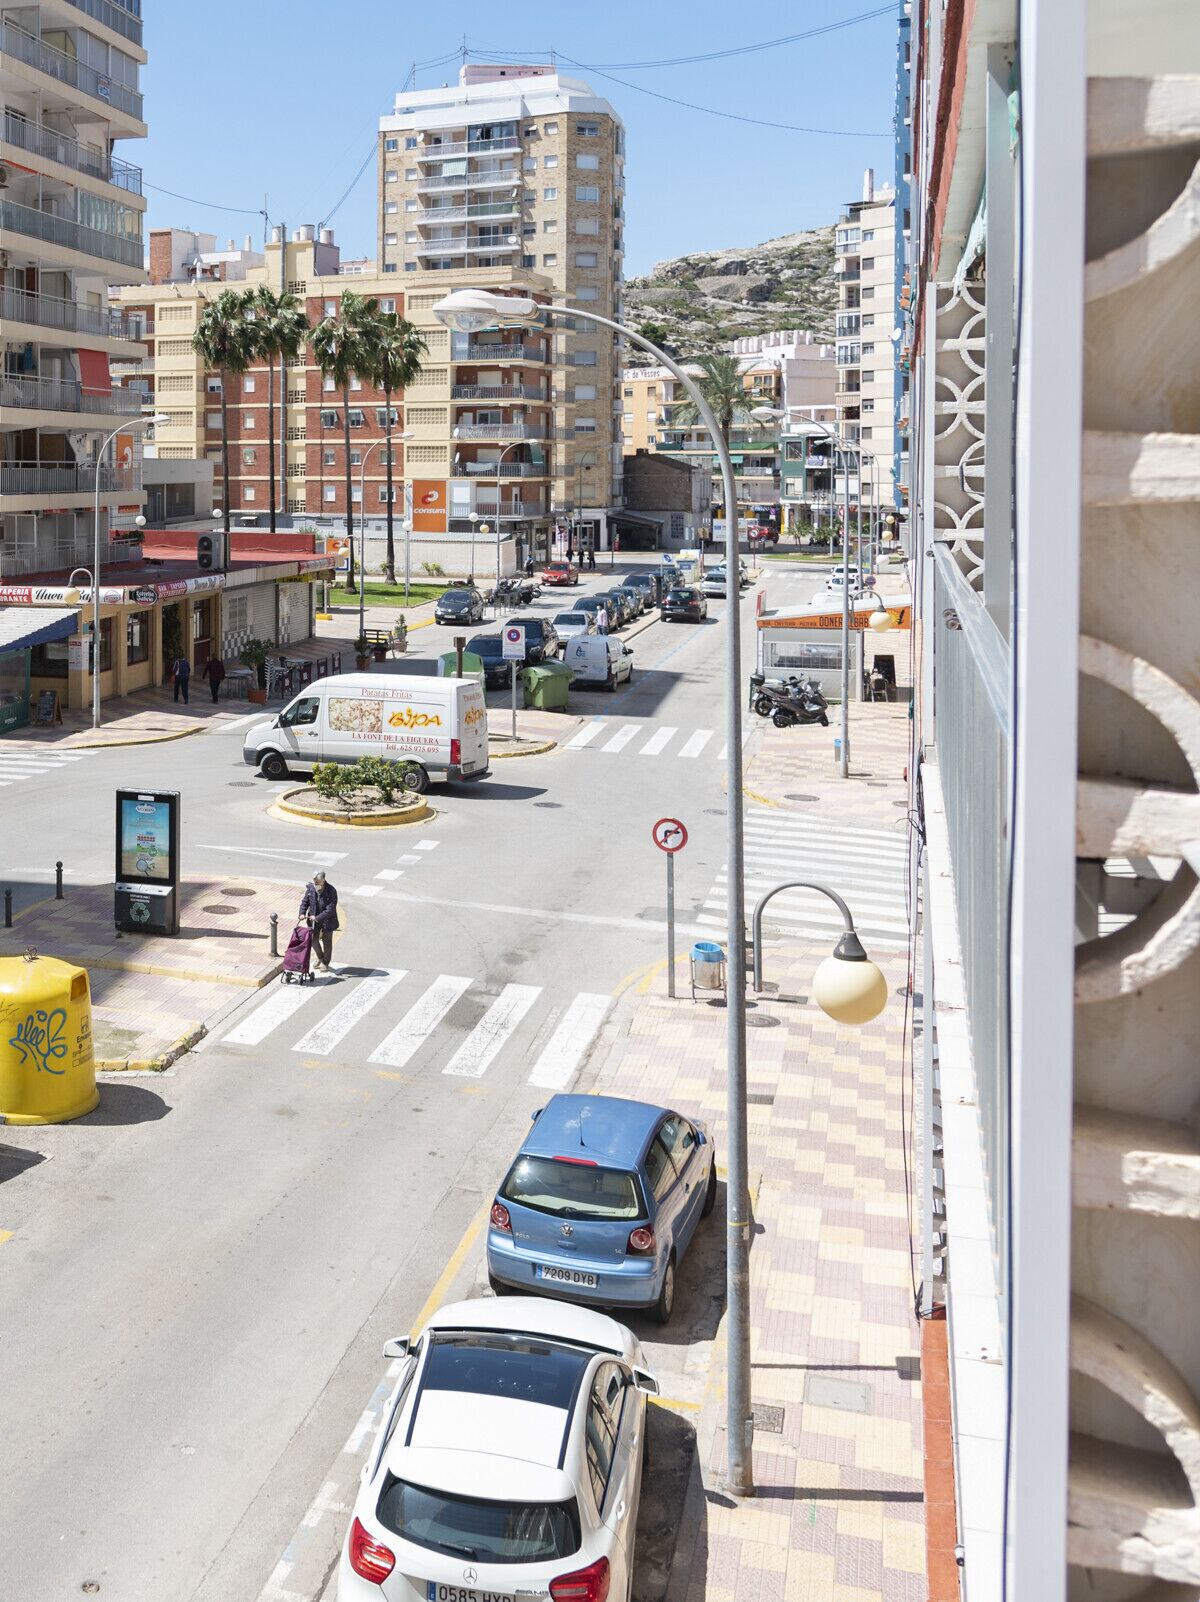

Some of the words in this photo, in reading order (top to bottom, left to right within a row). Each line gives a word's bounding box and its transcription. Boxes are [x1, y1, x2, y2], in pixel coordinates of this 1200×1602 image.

[361, 688, 389, 698] Patatas
[391, 689, 413, 698] Fritas
[363, 733, 382, 741] FONT
[384, 734, 393, 742] DE
[406, 736, 440, 744] FIGUERA
[544, 1267, 571, 1281] 7209
[573, 1272, 594, 1285] DYB
[439, 1586, 477, 1602] 0585
